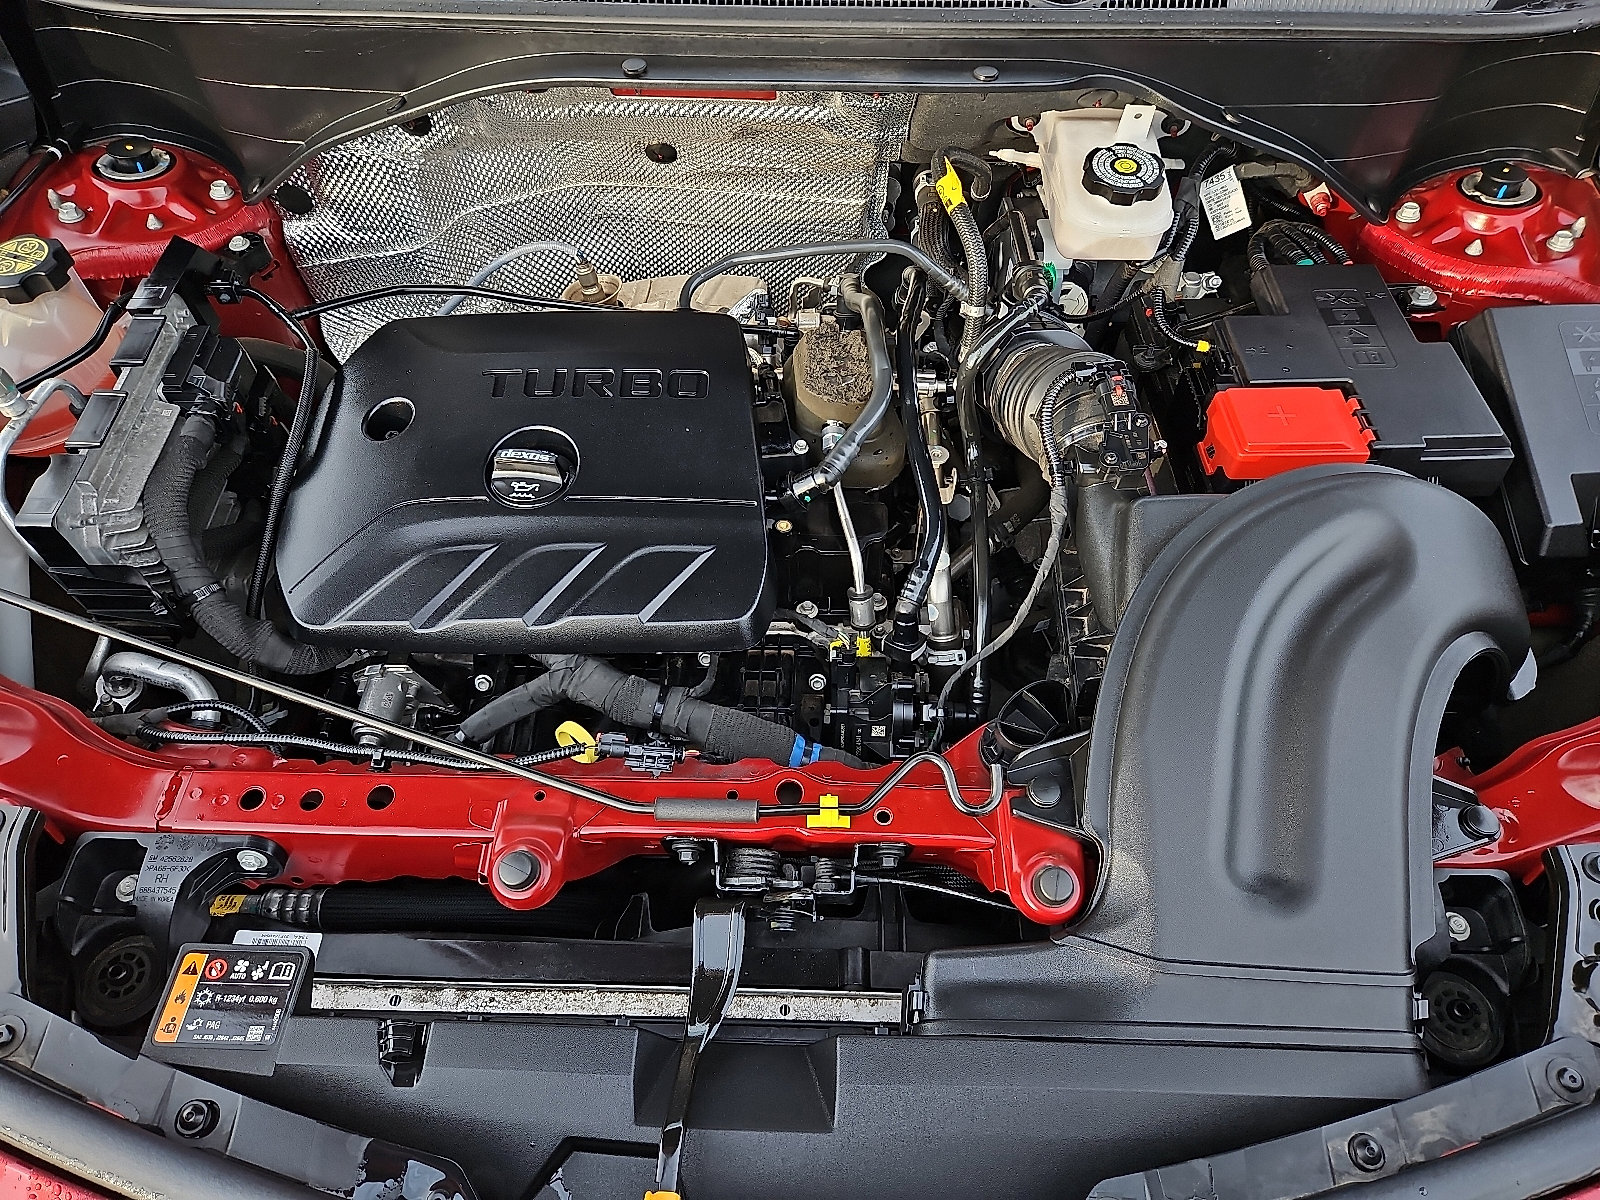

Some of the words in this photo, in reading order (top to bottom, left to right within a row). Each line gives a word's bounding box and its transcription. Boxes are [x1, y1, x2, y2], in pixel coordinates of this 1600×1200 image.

[1203, 171, 1226, 188] 7435
[482, 368, 710, 399] TURBO
[500, 449, 550, 462] dexos
[154, 873, 170, 884] RH
[229, 972, 247, 980] AUTO
[215, 994, 246, 1003] R-1234yf
[249, 995, 268, 1004] 0.600
[268, 996, 279, 1005] kg
[205, 1020, 221, 1030] PAG
